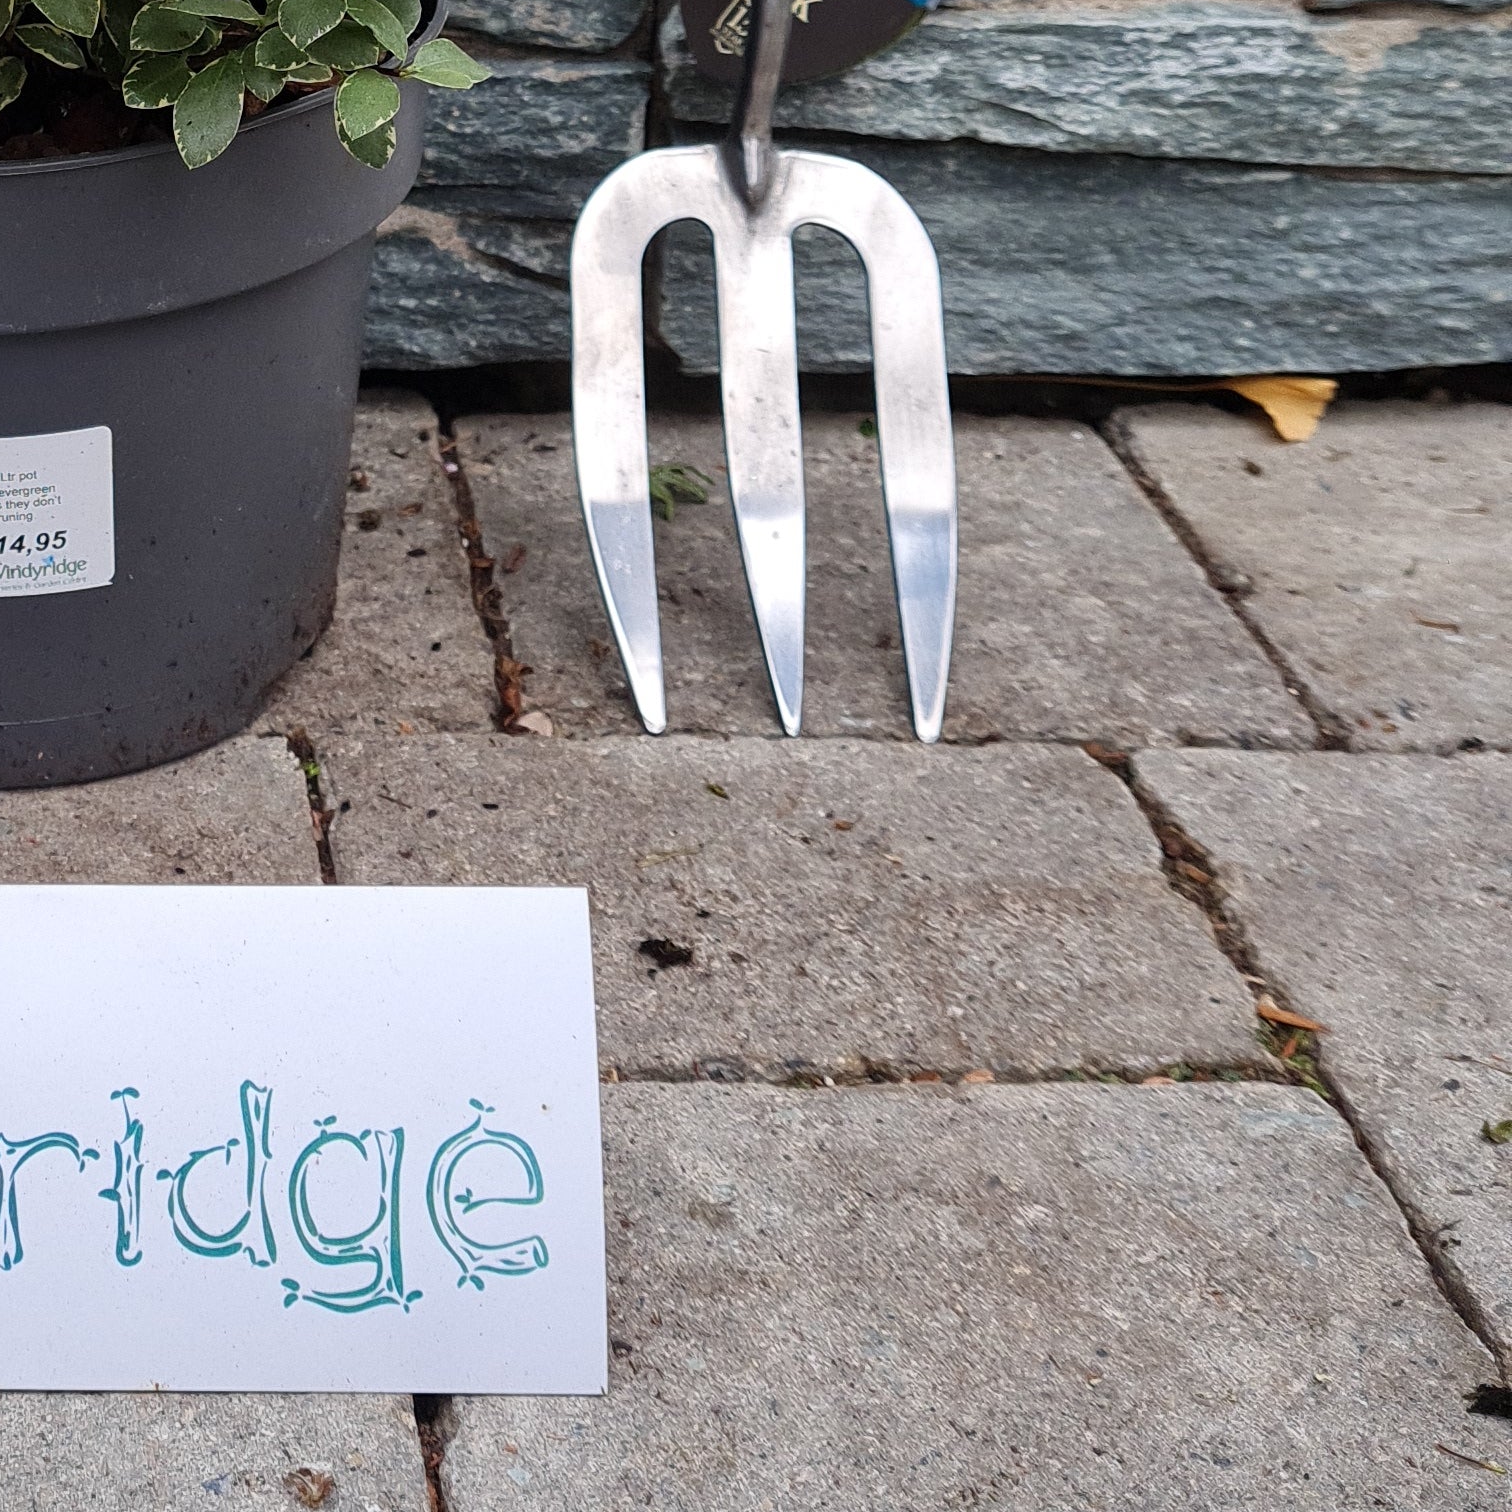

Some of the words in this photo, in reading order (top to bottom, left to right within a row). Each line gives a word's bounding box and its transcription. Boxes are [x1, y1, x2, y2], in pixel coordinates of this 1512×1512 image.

[0, 472, 16, 482] Ltr
[19, 470, 38, 483] pot
[5, 499, 30, 511] they
[32, 494, 62, 508] don't
